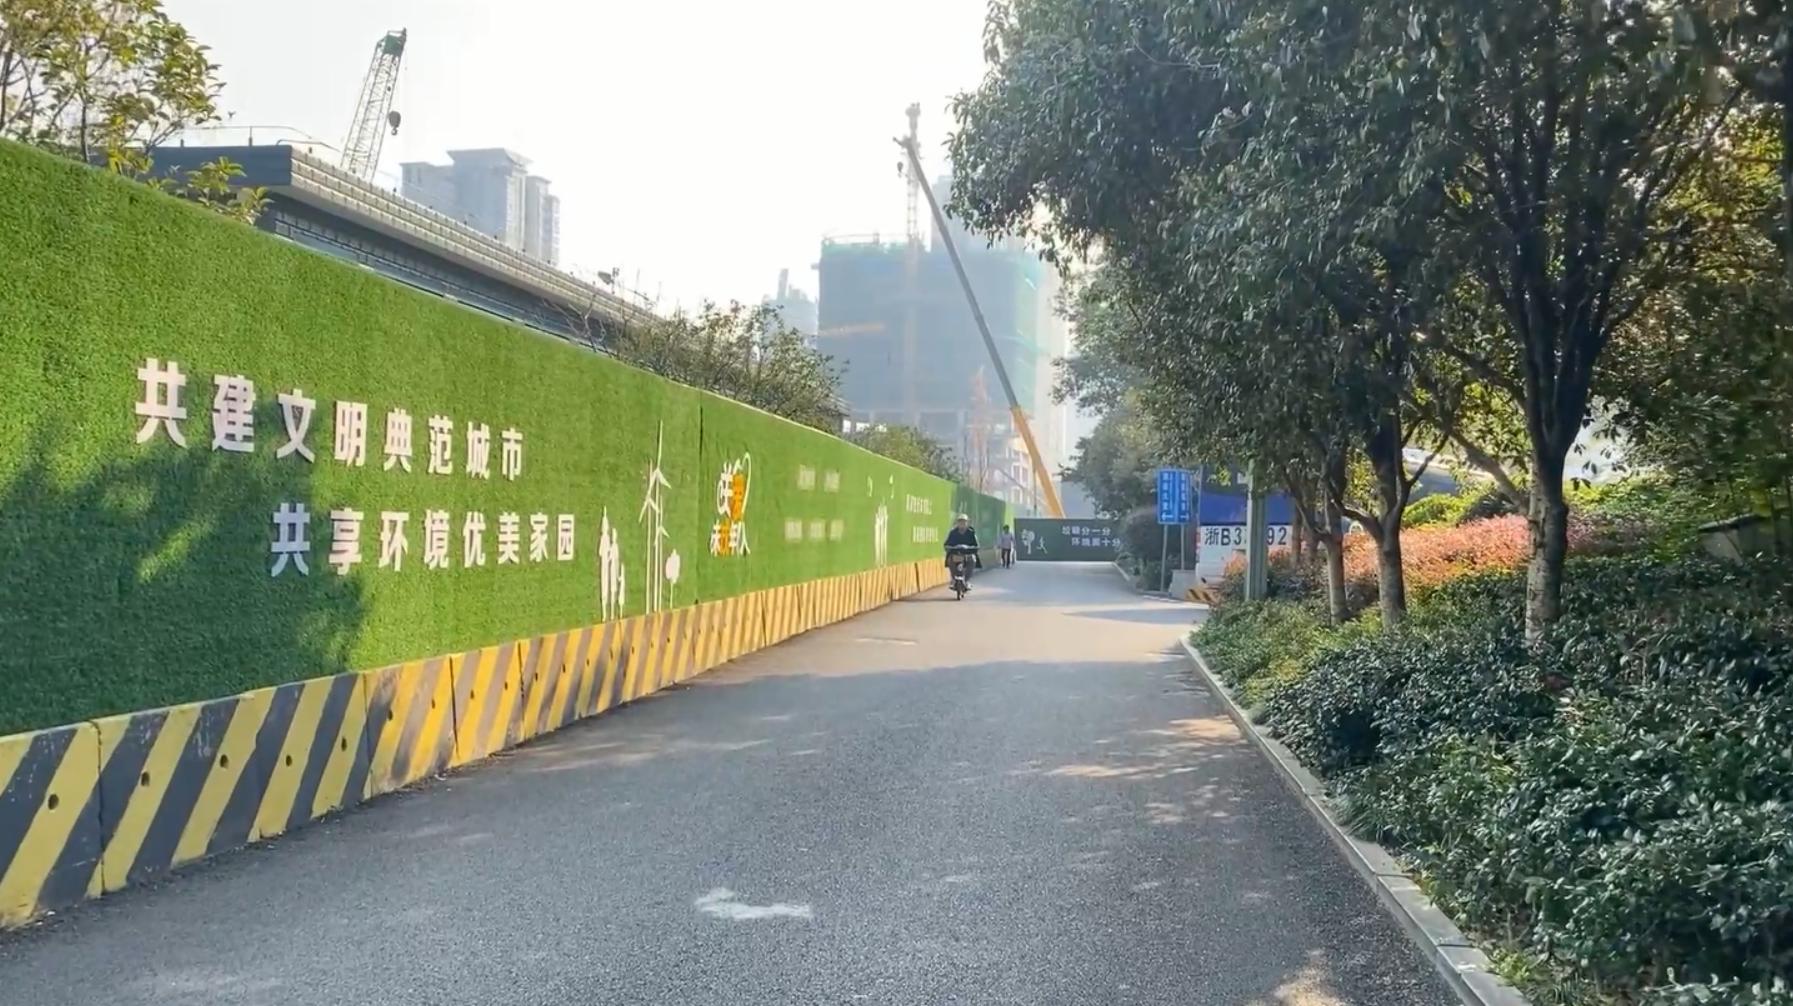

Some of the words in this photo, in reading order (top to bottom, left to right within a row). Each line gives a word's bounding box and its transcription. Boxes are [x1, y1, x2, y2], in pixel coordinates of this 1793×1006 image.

[135, 358, 523, 481] 共建文明典范城市
[270, 502, 575, 577] 共享环境优美家园
[1204, 527, 1288, 546] 浙B392
